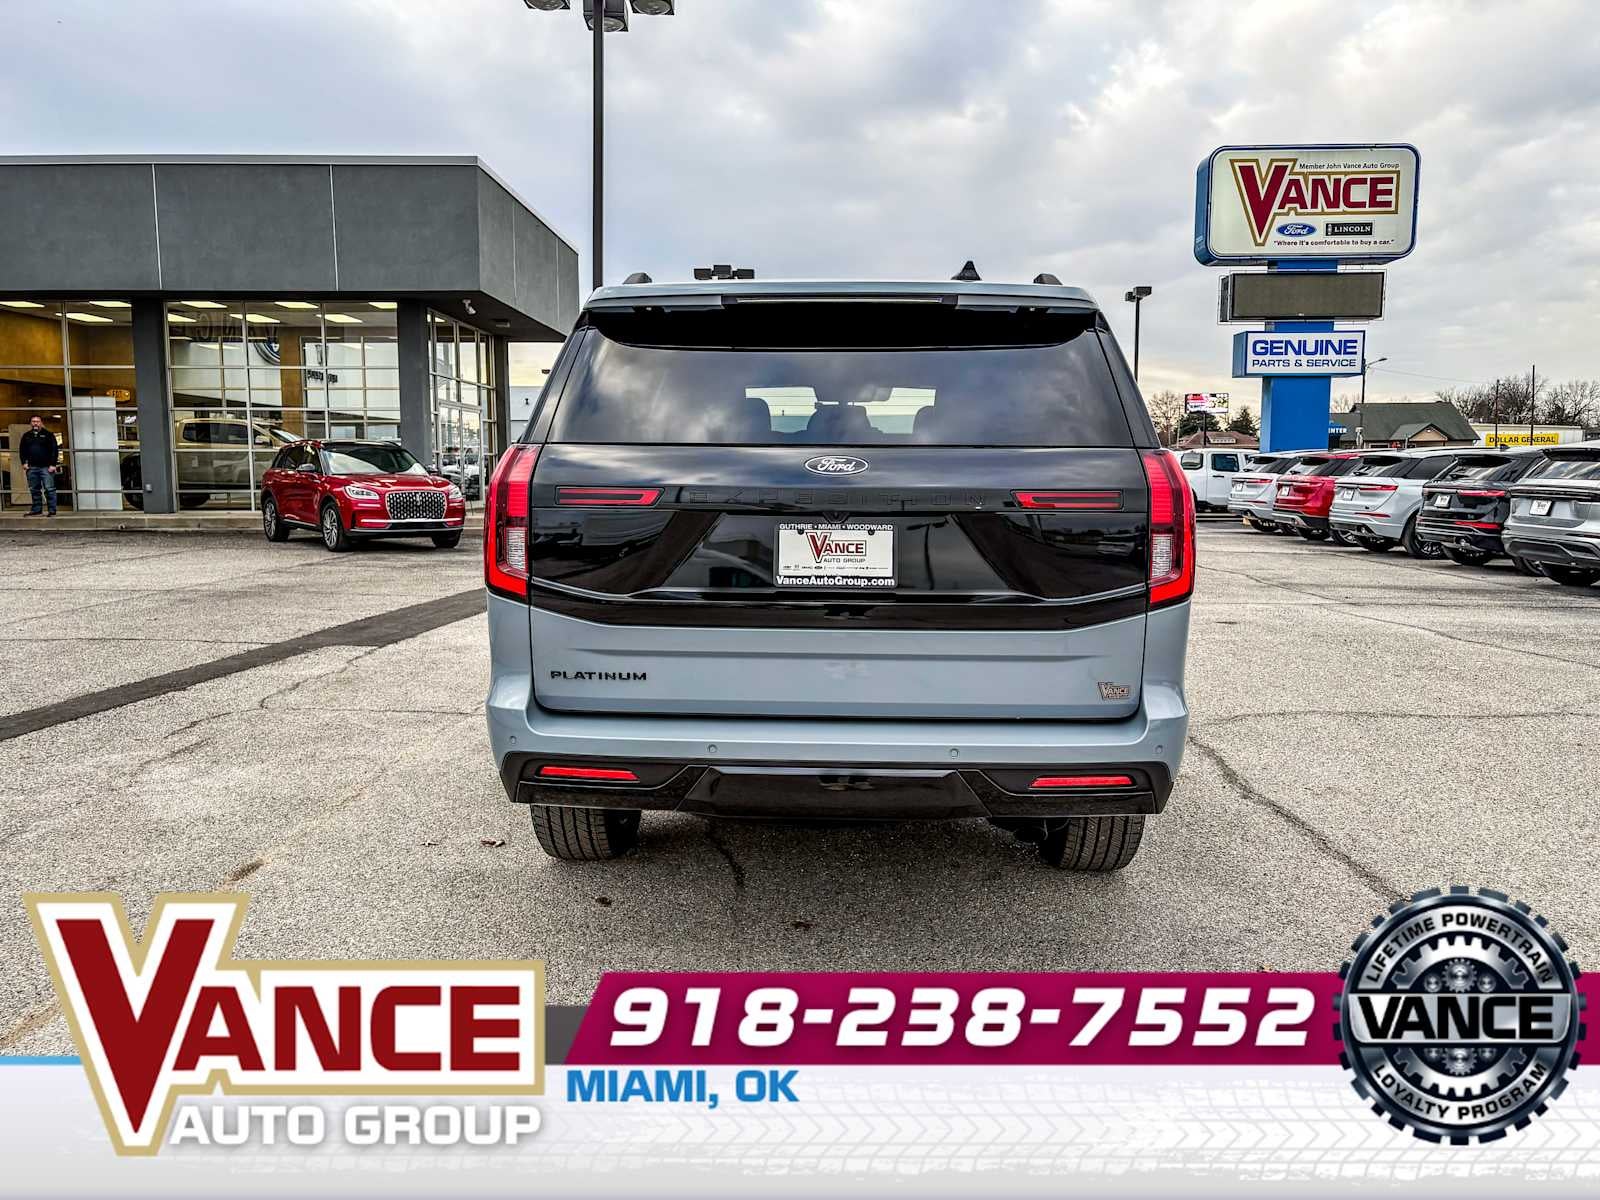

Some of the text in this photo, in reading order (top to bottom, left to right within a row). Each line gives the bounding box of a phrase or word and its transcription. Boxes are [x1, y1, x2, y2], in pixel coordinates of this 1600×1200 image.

[1380, 162, 1400, 170] Group
[1236, 163, 1395, 240] VANCE
[1333, 225, 1372, 234] LINCOLN
[1360, 239, 1372, 247] buy
[1252, 339, 1358, 356] GENUINE
[1252, 359, 1356, 367] PARTS & SERVICE
[846, 523, 893, 531] WOODWARD
[808, 533, 865, 561] VANCE
[776, 575, 895, 587] VanceAutoGroup.com
[550, 670, 647, 681] PLATINUM
